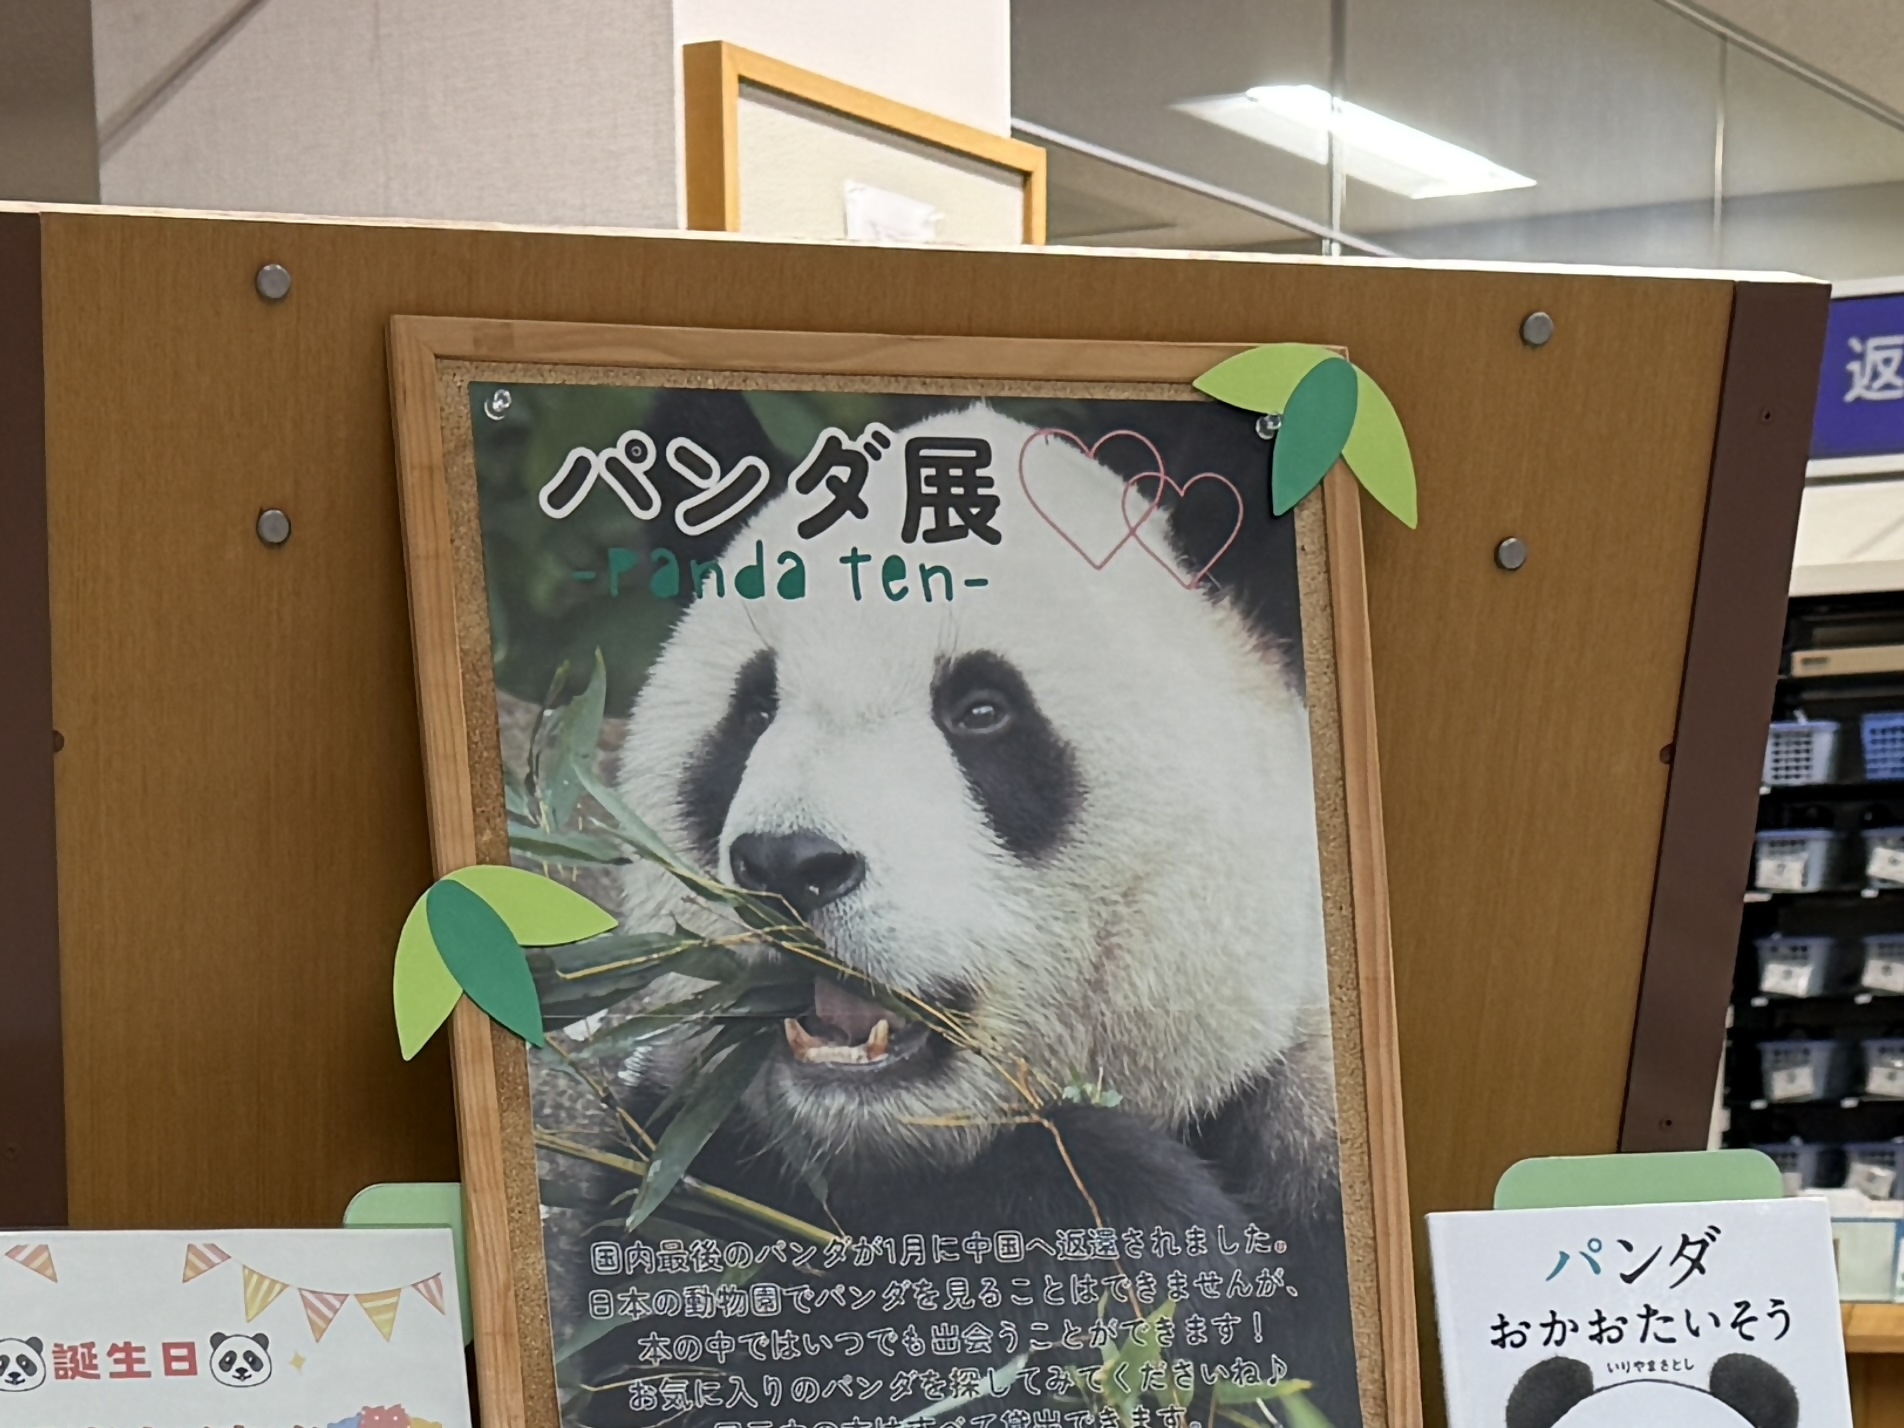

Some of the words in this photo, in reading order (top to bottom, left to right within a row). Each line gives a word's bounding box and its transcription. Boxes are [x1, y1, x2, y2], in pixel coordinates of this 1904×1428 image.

[537, 420, 1004, 548] パンダ展
[589, 1223, 1287, 1277] 国内最後のパンダが1月に中国へ返還されました。
[1544, 1224, 1723, 1290] パンダ
[587, 1269, 1301, 1321] 日本の動物園でパンダを見ることはできませんが、
[636, 1313, 1265, 1367] 本の中ではいつでも出会うことができます！
[1489, 1297, 1792, 1349] おかおたいそう
[51, 1340, 199, 1382] 誕生日
[1605, 1358, 1696, 1374] いりやまさとし
